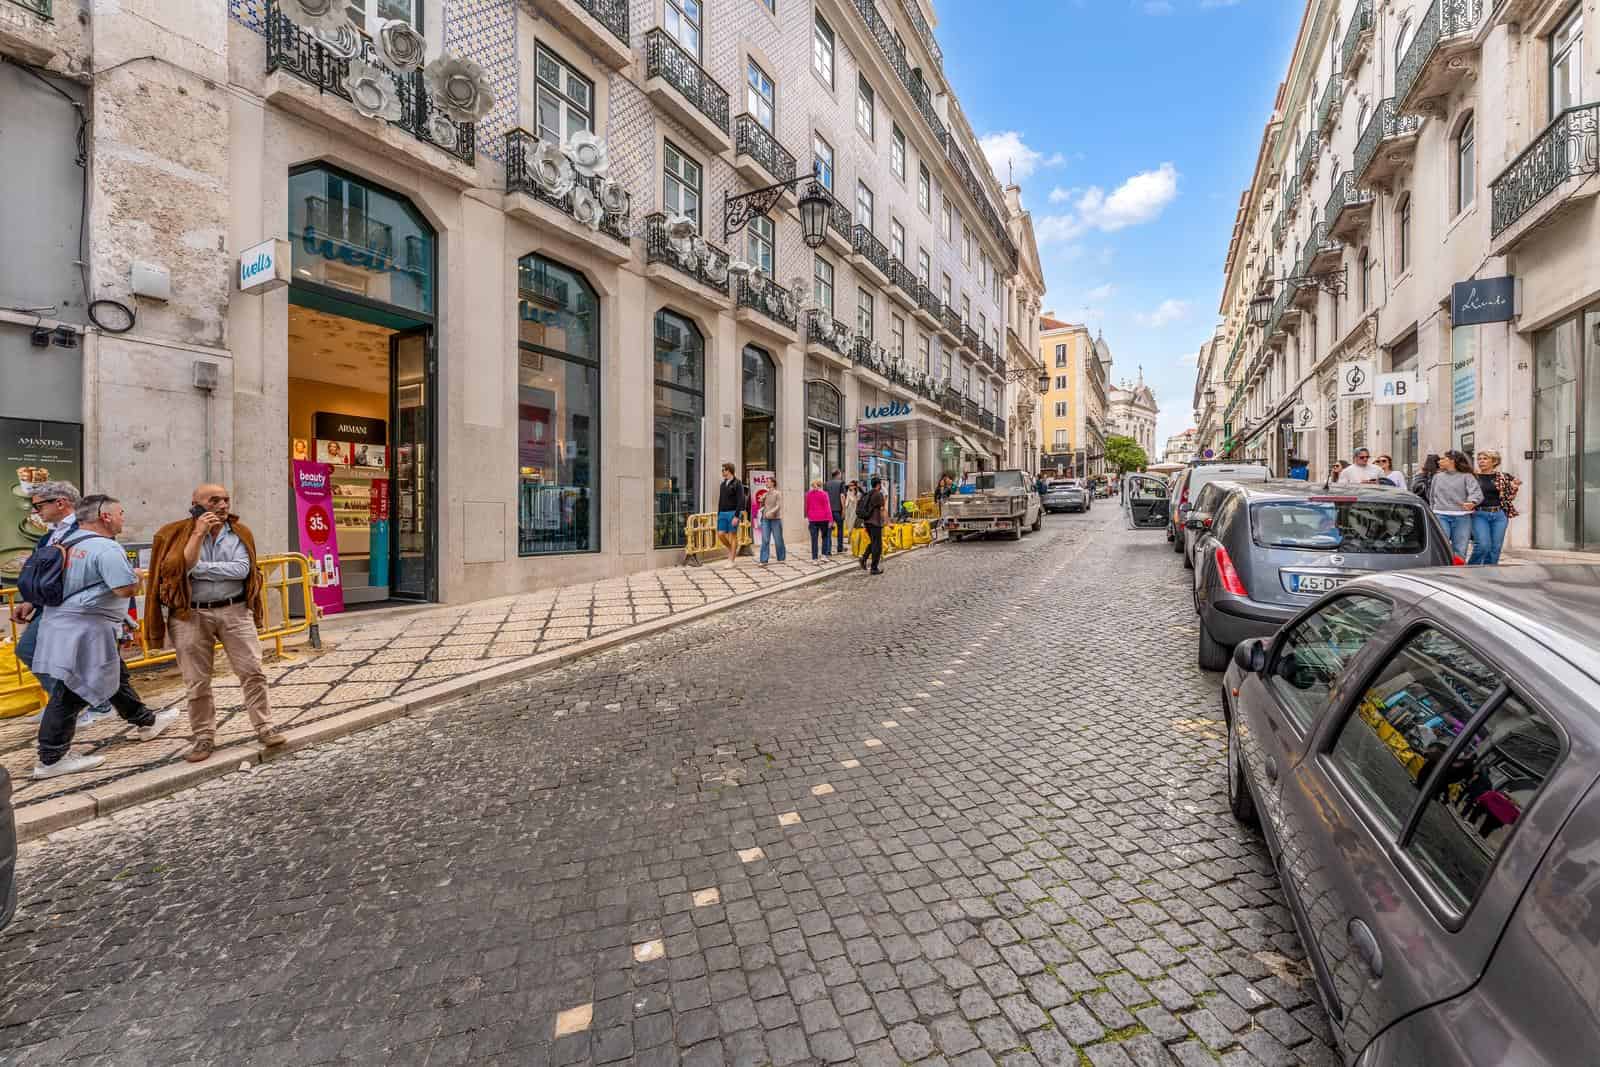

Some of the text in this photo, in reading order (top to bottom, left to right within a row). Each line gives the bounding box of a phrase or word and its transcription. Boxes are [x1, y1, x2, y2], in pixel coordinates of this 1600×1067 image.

[242, 253, 271, 280] wells
[1384, 380, 1406, 396] AB
[865, 400, 912, 418] wells
[338, 424, 367, 434] ARMANI
[299, 469, 326, 487] beauty
